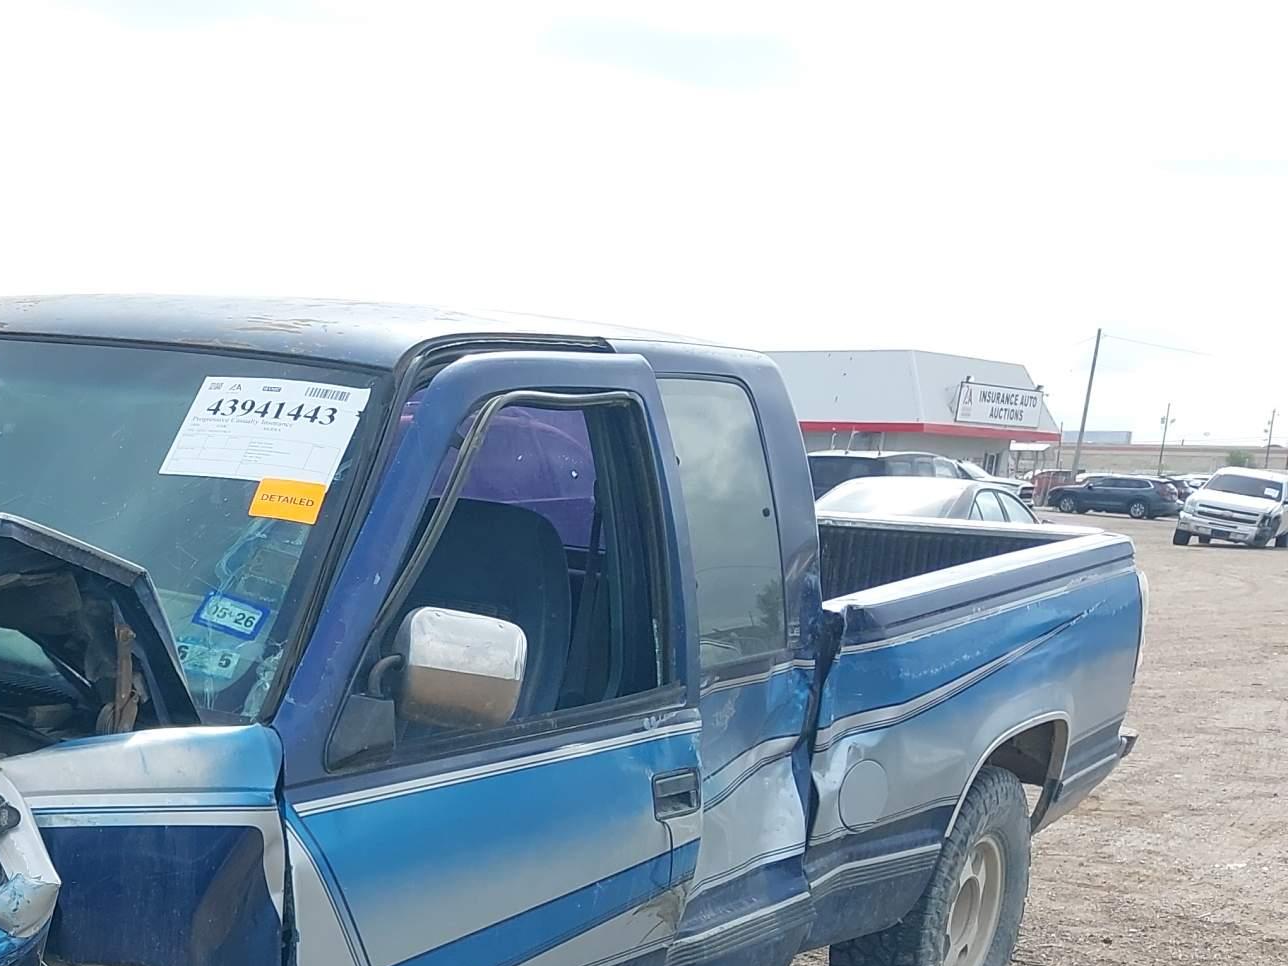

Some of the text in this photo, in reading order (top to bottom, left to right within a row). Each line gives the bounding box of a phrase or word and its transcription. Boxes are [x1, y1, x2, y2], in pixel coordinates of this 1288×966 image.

[979, 390, 1038, 408] INSURANCE AUTO
[206, 398, 338, 426] 43941443
[989, 406, 1024, 421] AUCTIONS
[261, 493, 315, 507] DETAILED
[233, 612, 256, 628] 26
